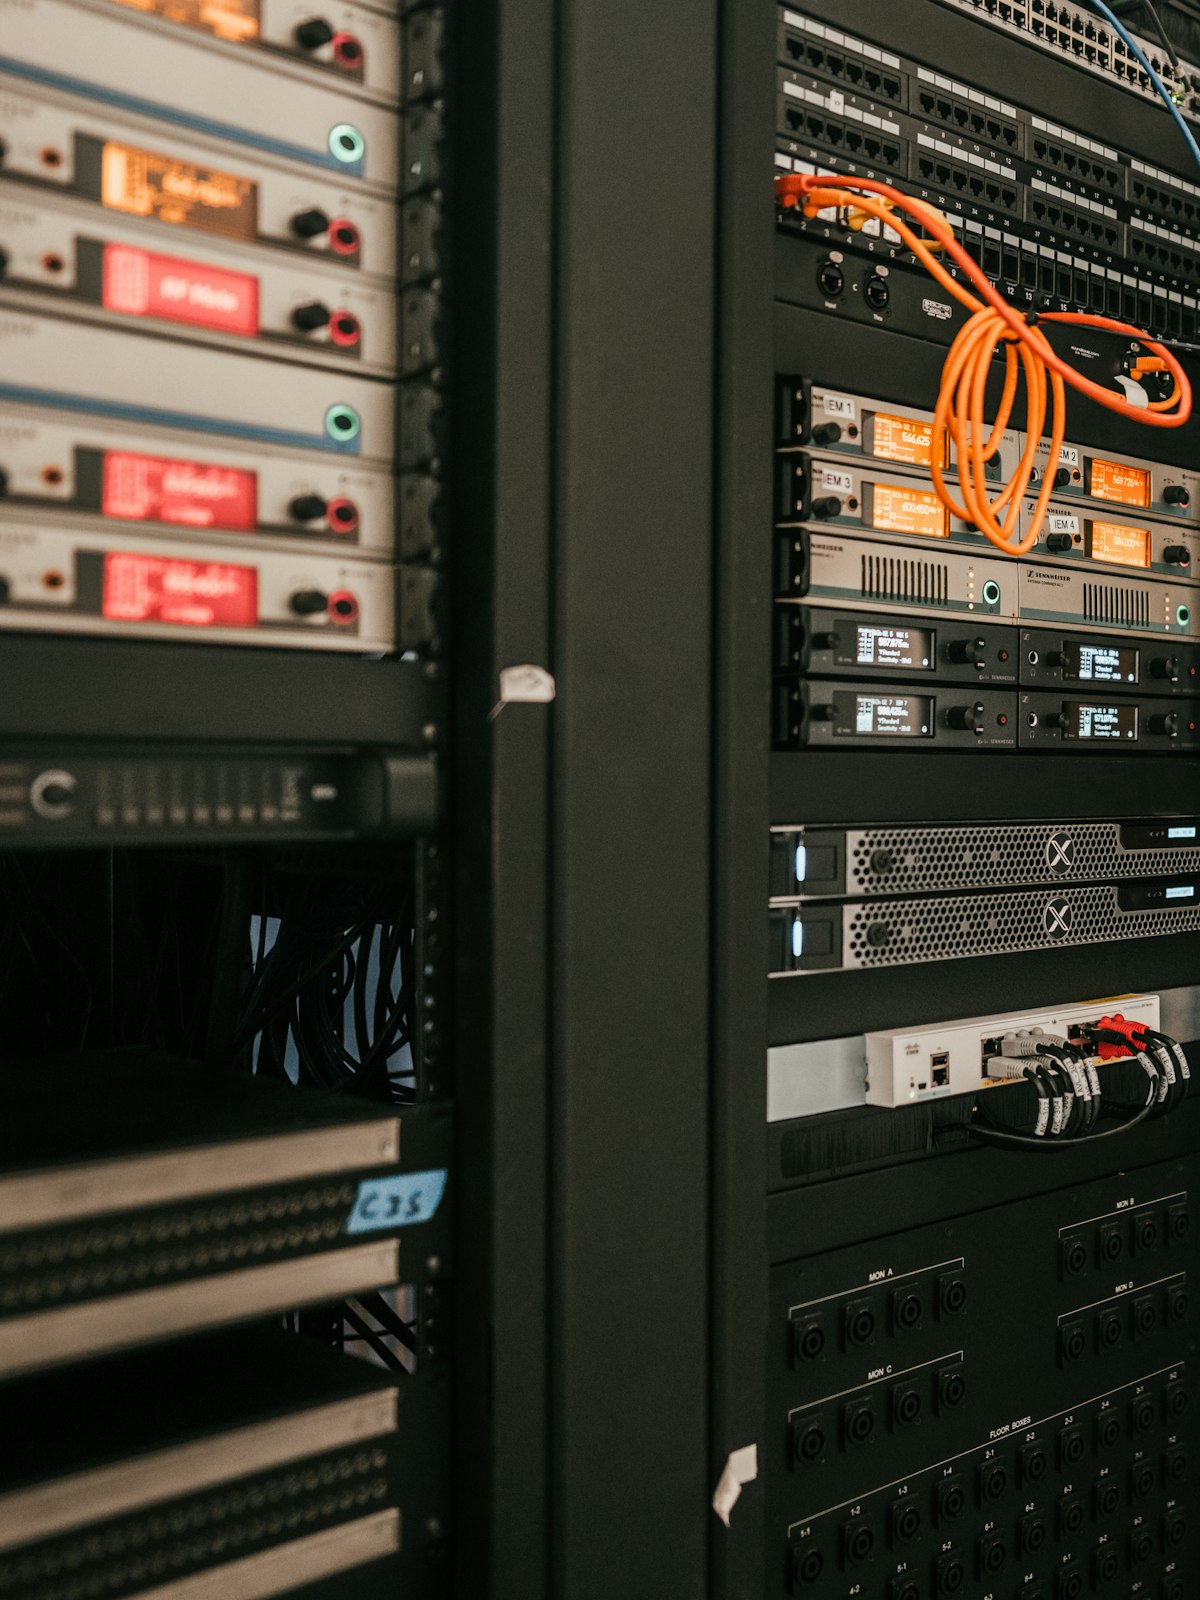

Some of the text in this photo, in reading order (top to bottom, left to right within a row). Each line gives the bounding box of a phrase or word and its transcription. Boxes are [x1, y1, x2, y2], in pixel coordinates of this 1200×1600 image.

[801, 222, 806, 230] 2
[824, 229, 829, 237] 3
[869, 243, 873, 251] 5
[950, 269, 956, 278] 9
[1008, 287, 1014, 295] 12
[1026, 292, 1032, 300] 13
[1060, 303, 1067, 312] 15
[848, 403, 852, 413] 1
[1071, 452, 1076, 461] 2
[845, 478, 851, 489] 3
[1054, 519, 1075, 530] IEM 4
[1035, 572, 1071, 582] SENNHEISER
[1116, 1200, 1129, 1209] MON
[869, 1268, 894, 1284] MON A
[1115, 1281, 1134, 1294] MON D
[868, 1364, 893, 1381] MON C
[989, 1416, 1032, 1440] FLOOR BOXES
[801, 1528, 810, 1537] 1-1
[851, 1506, 860, 1515] 1-2
[899, 1486, 907, 1495] 1-3
[944, 1467, 952, 1476] 1-4
[986, 1450, 994, 1458] 2-1
[1065, 1416, 1073, 1425] 2-3
[850, 1585, 859, 1594] 4-2
[898, 1563, 906, 1572] 5-1
[943, 1541, 951, 1551] 5-2
[985, 1522, 993, 1531] 6-1
[1026, 1503, 1034, 1511] 6-2
